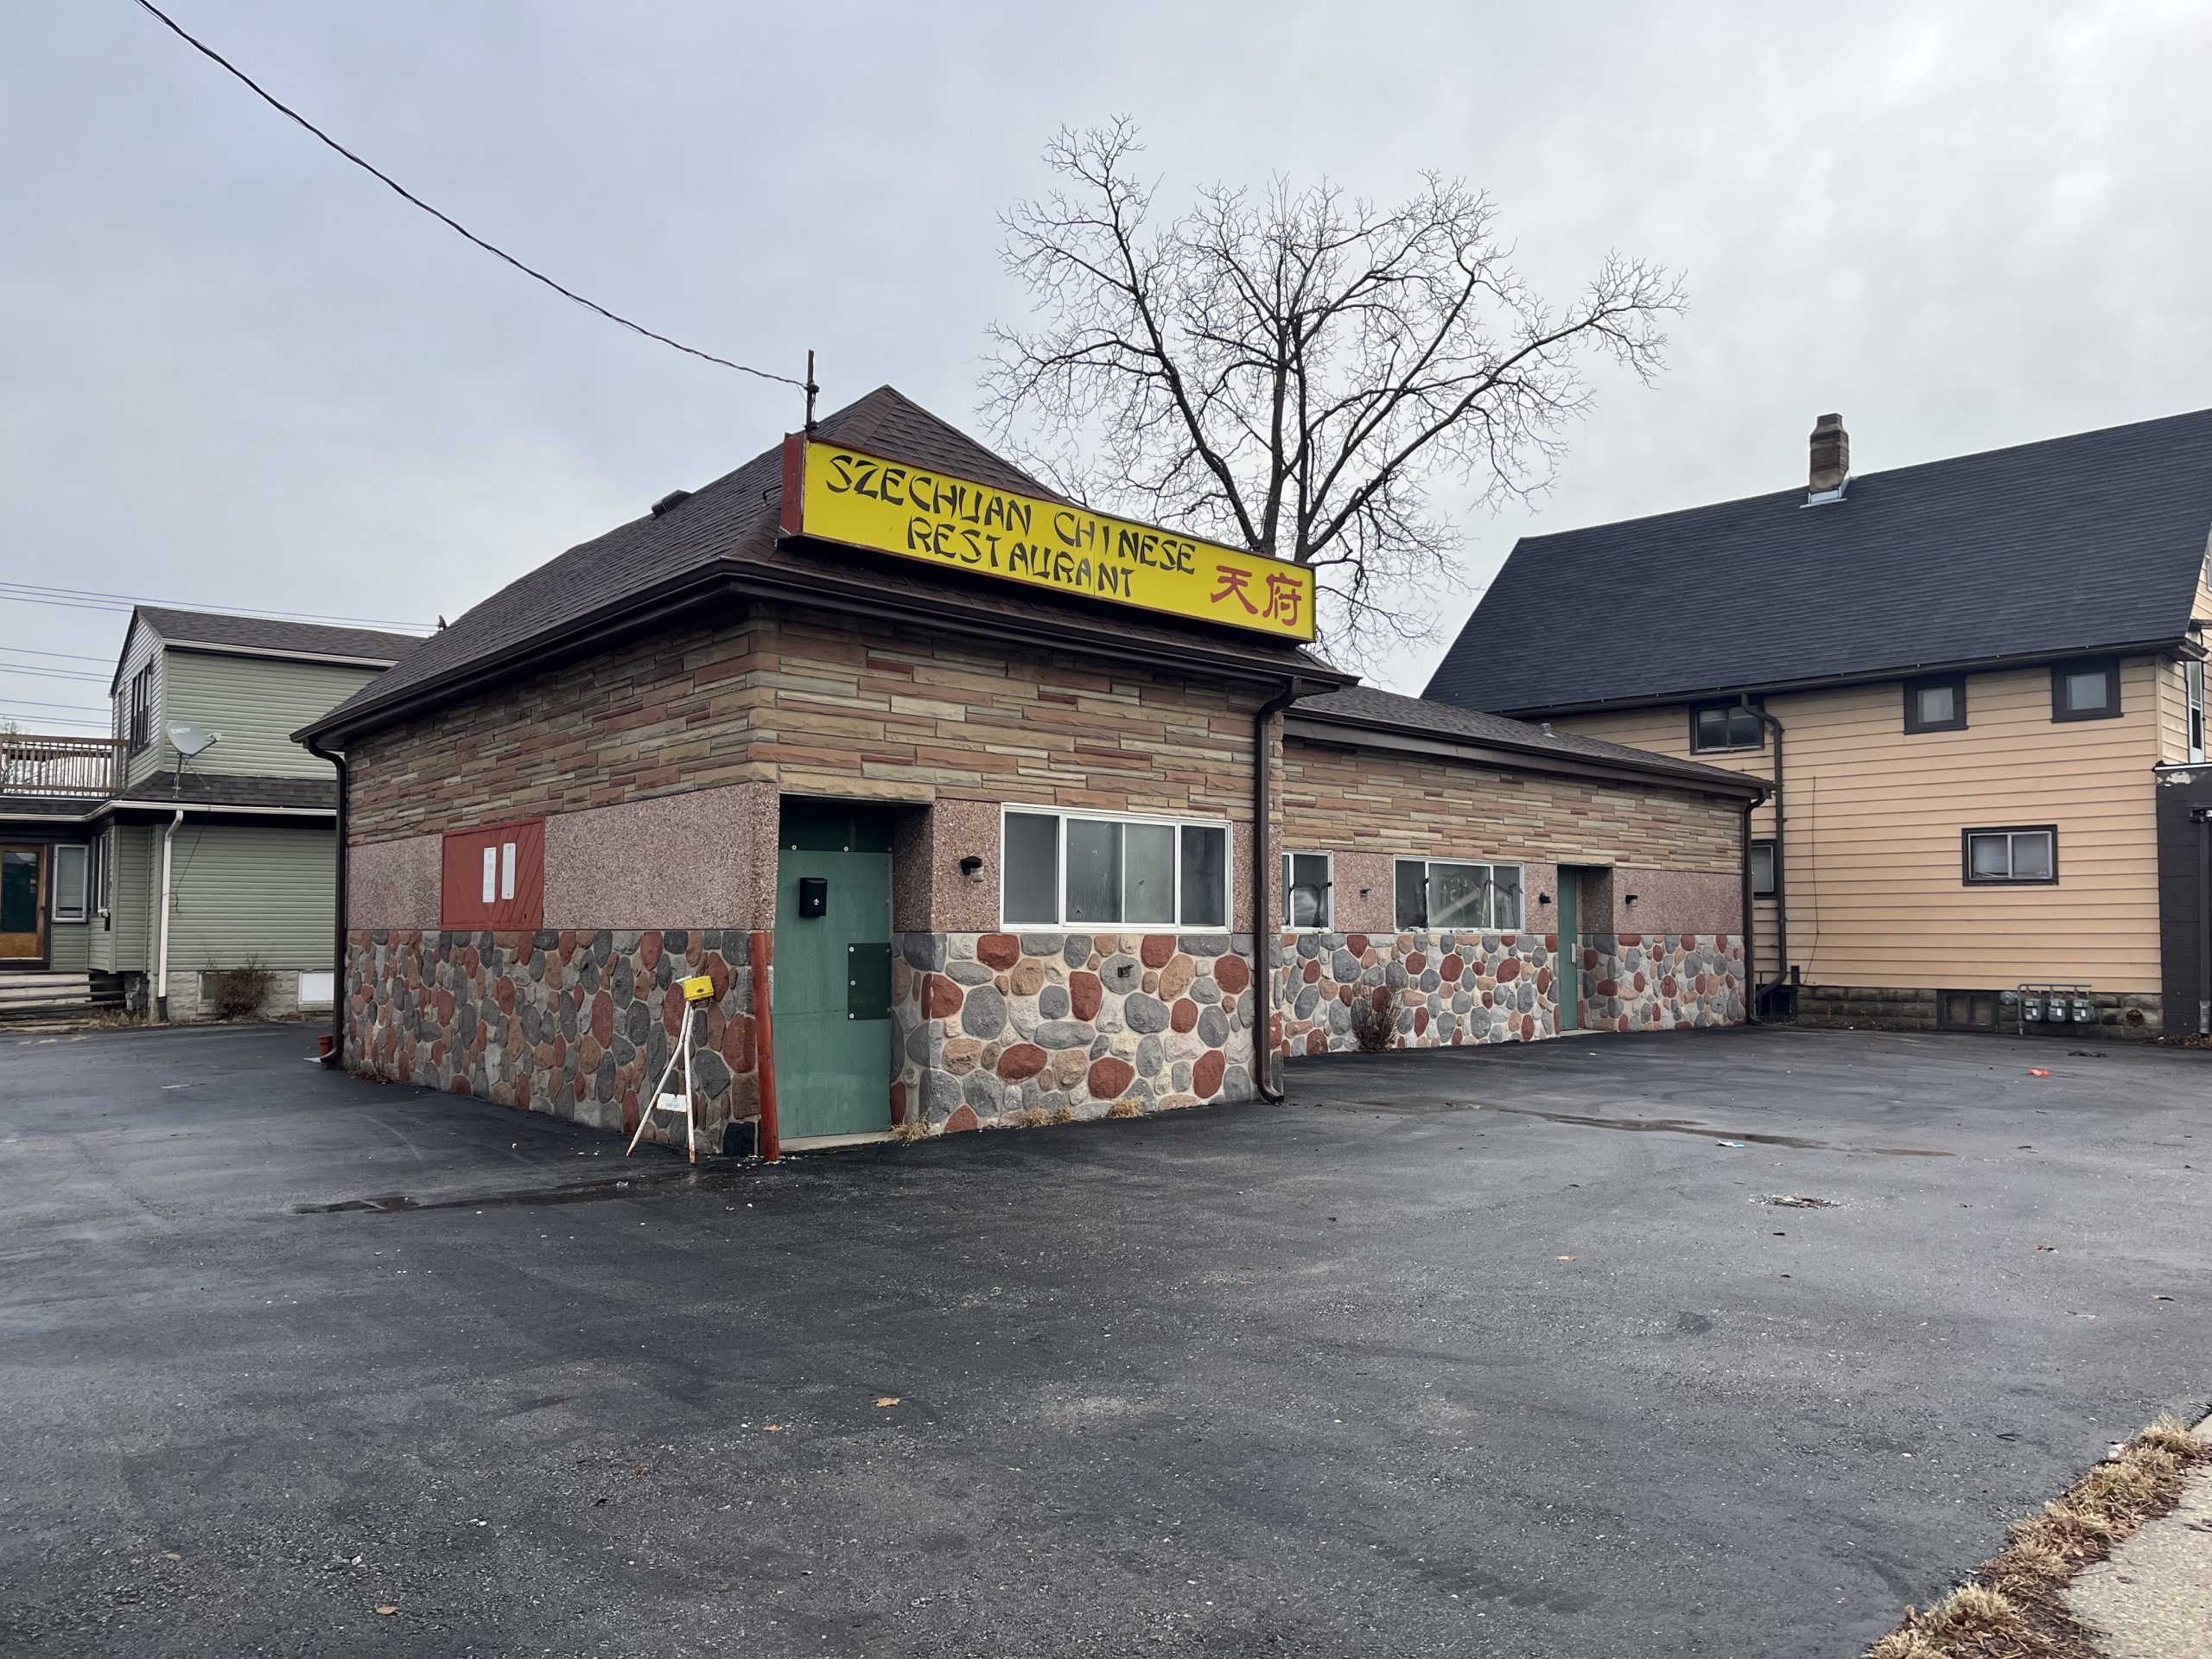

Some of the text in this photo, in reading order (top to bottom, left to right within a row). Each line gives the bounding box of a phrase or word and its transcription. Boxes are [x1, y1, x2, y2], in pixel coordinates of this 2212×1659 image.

[825, 454, 1197, 575] SZECHUAN CHINESE
[906, 516, 1135, 598] RESTAURANT
[1210, 564, 1303, 626] 天府
